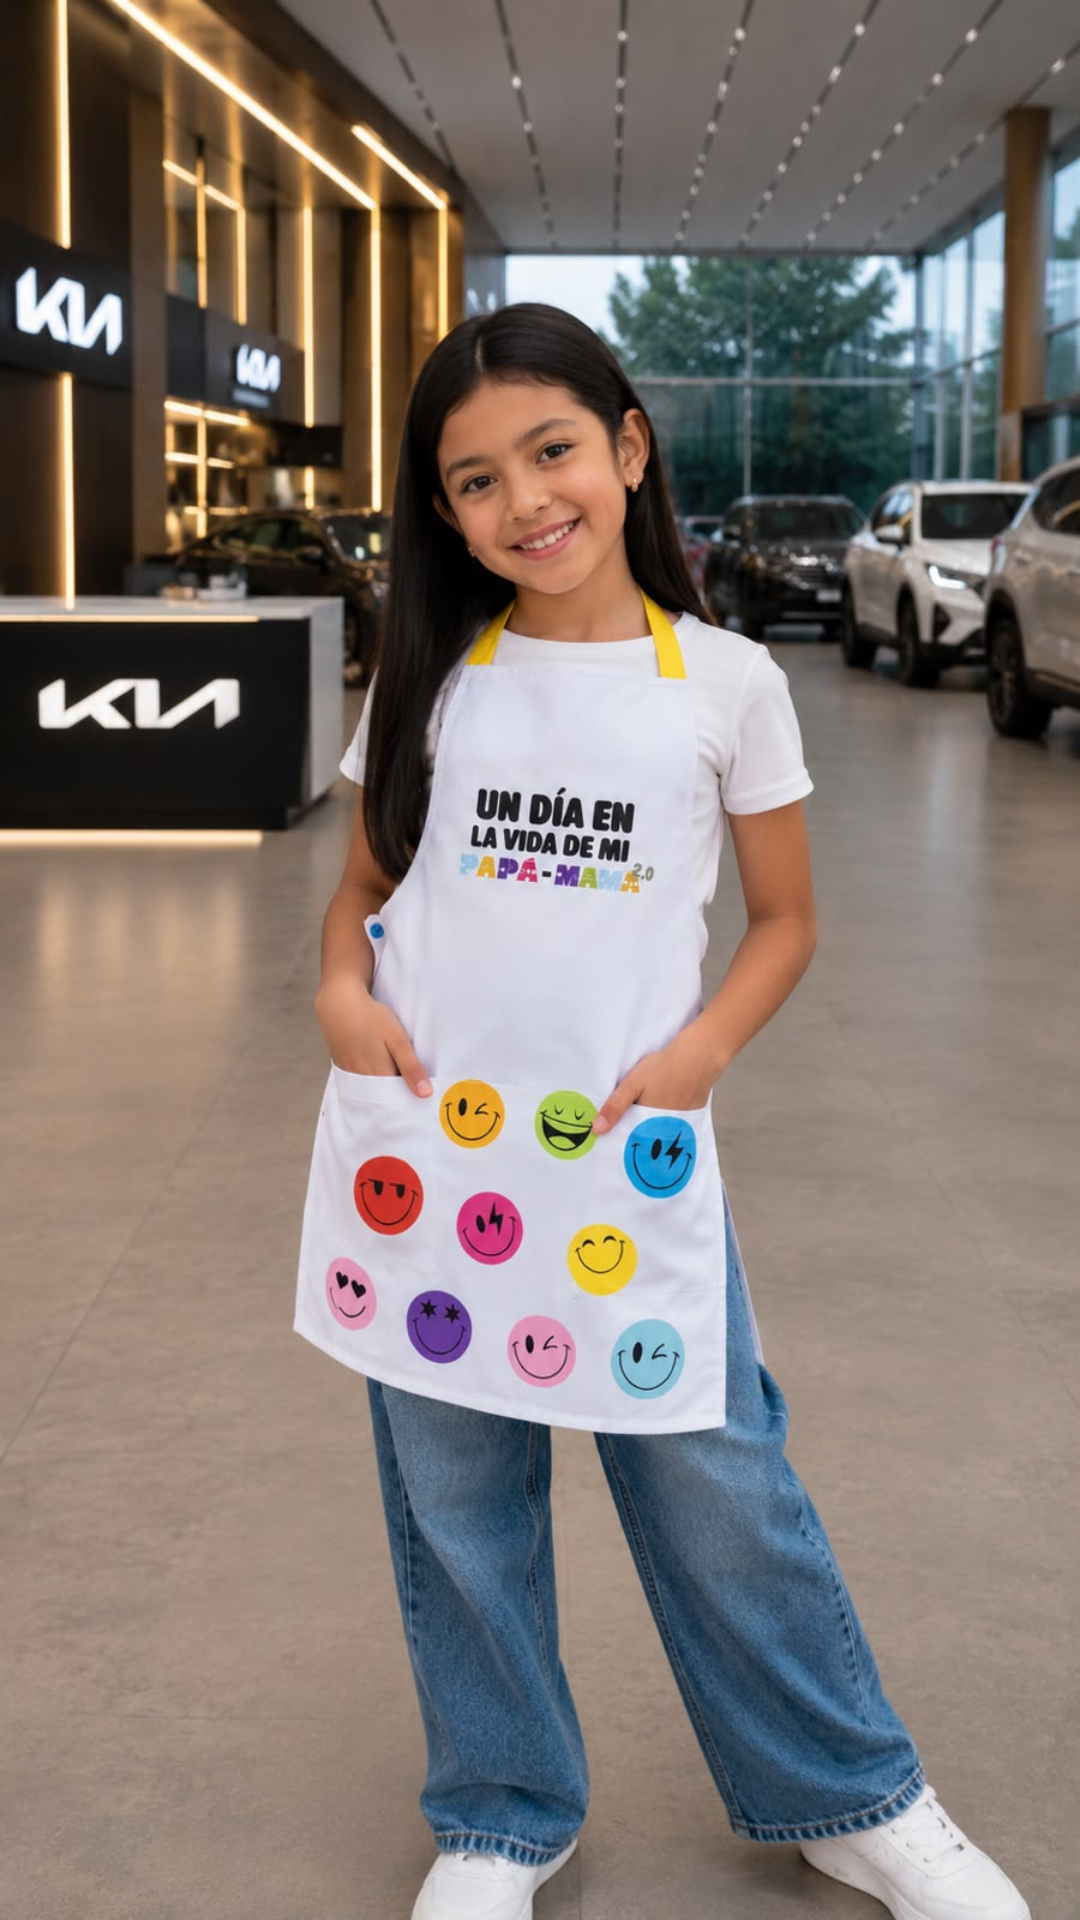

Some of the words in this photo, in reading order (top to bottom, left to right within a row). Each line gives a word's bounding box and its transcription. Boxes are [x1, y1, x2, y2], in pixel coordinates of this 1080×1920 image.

[15, 266, 123, 356] KIA
[38, 678, 241, 730] KIA
[476, 788, 522, 822] UN
[529, 787, 584, 828] DÍA
[592, 799, 636, 833] EN
[470, 825, 497, 848] LA
[503, 828, 557, 855] VIDA
[563, 834, 595, 858] DE
[598, 838, 631, 863] MI
[632, 863, 655, 881] 2.0
